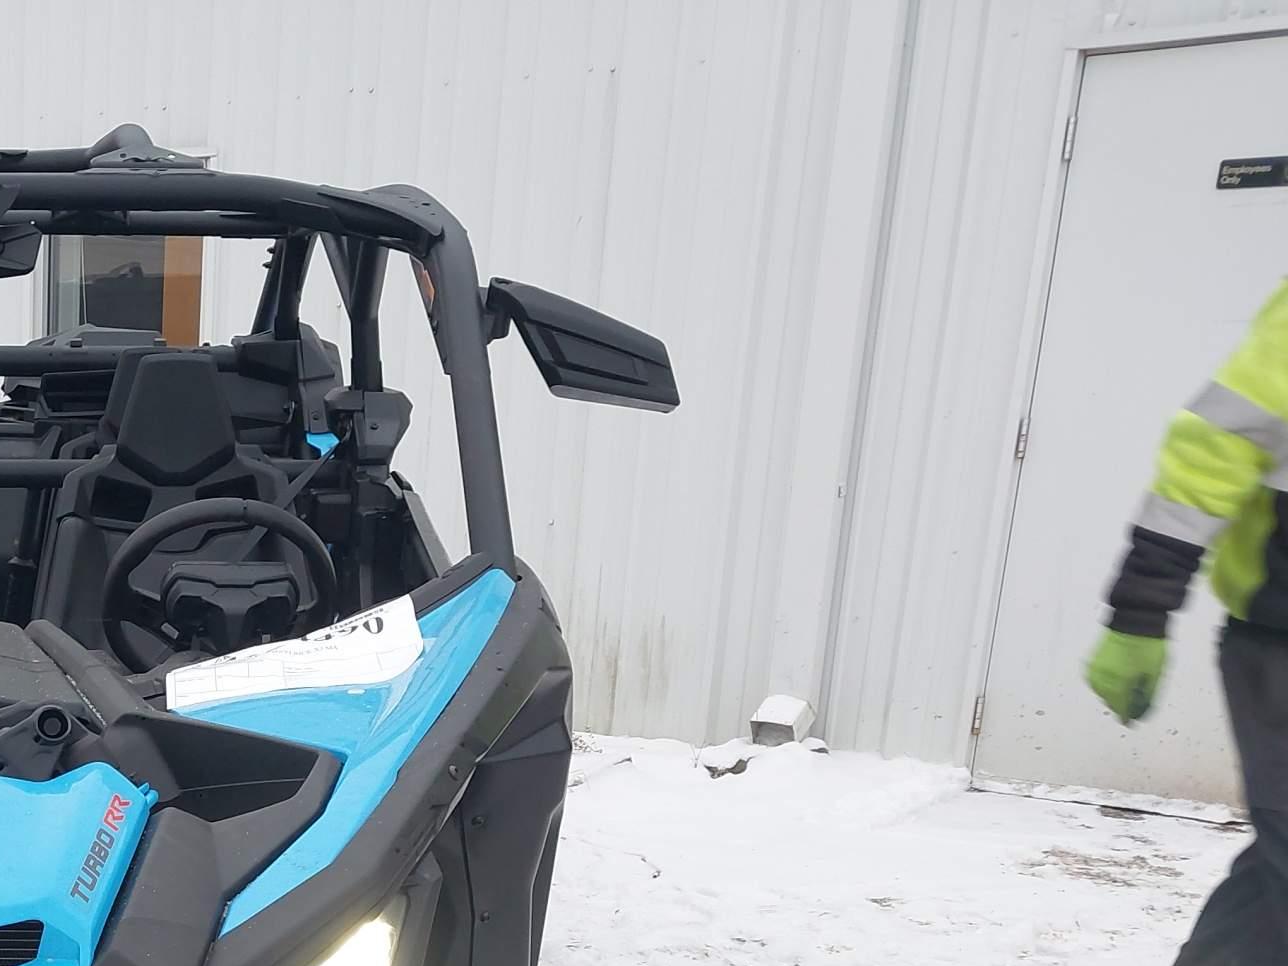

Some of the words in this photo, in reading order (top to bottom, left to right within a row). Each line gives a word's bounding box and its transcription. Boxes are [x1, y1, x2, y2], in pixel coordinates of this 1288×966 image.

[1222, 164, 1272, 175] Employees
[1219, 175, 1241, 185] Only
[70, 827, 115, 903] TURBO
[103, 793, 131, 832] RR
